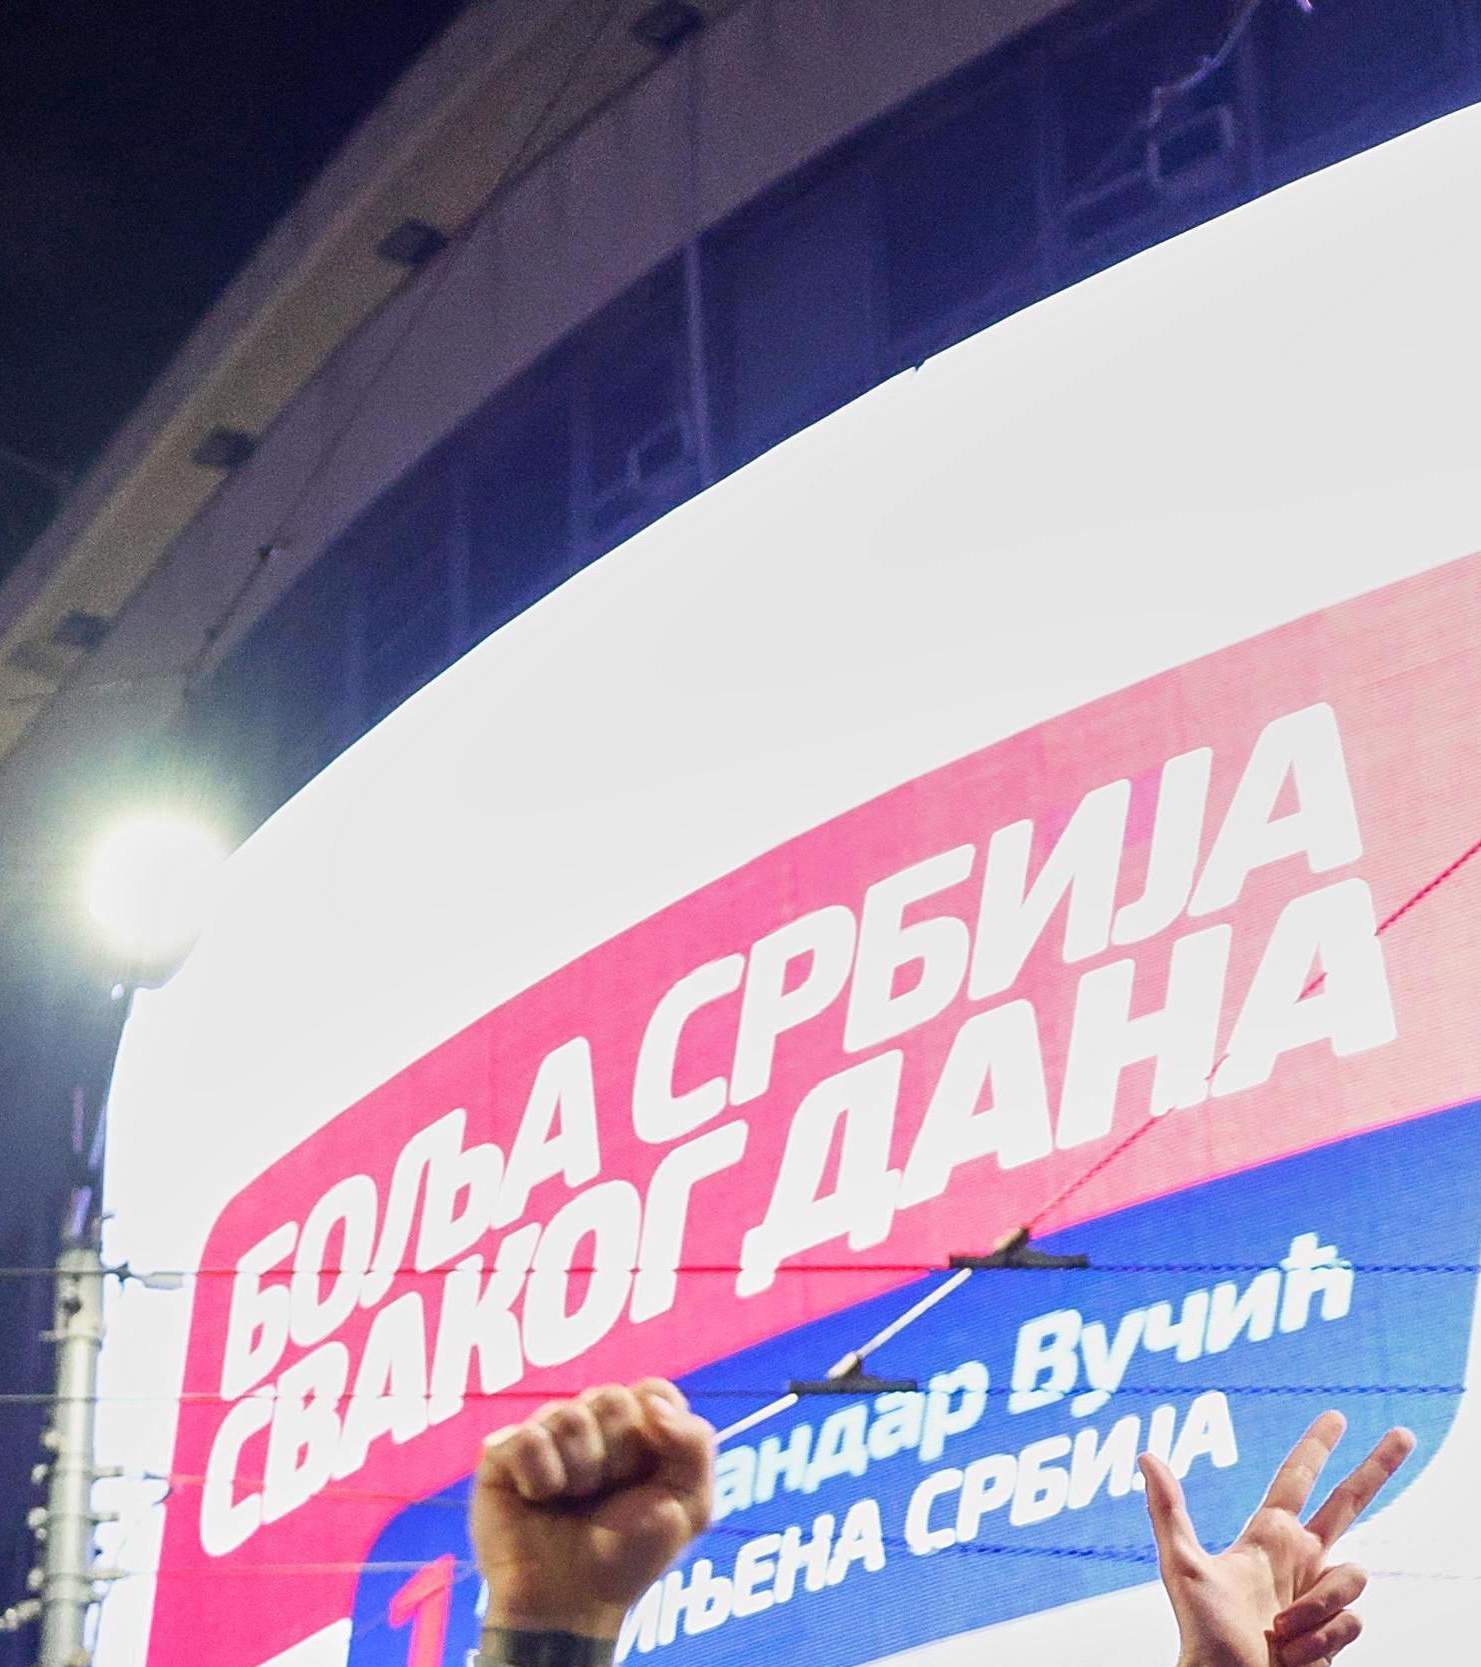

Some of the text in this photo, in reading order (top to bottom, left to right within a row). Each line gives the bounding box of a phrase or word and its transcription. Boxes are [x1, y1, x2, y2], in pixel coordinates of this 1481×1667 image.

[199, 876, 1398, 1558] СВАКОГ ДАНА
[220, 701, 1364, 1401] БОЉА СРБИЈА
[615, 1389, 1239, 1664] ИЊЕНА СРБИЈА
[714, 1232, 1354, 1522] андар Вучић
